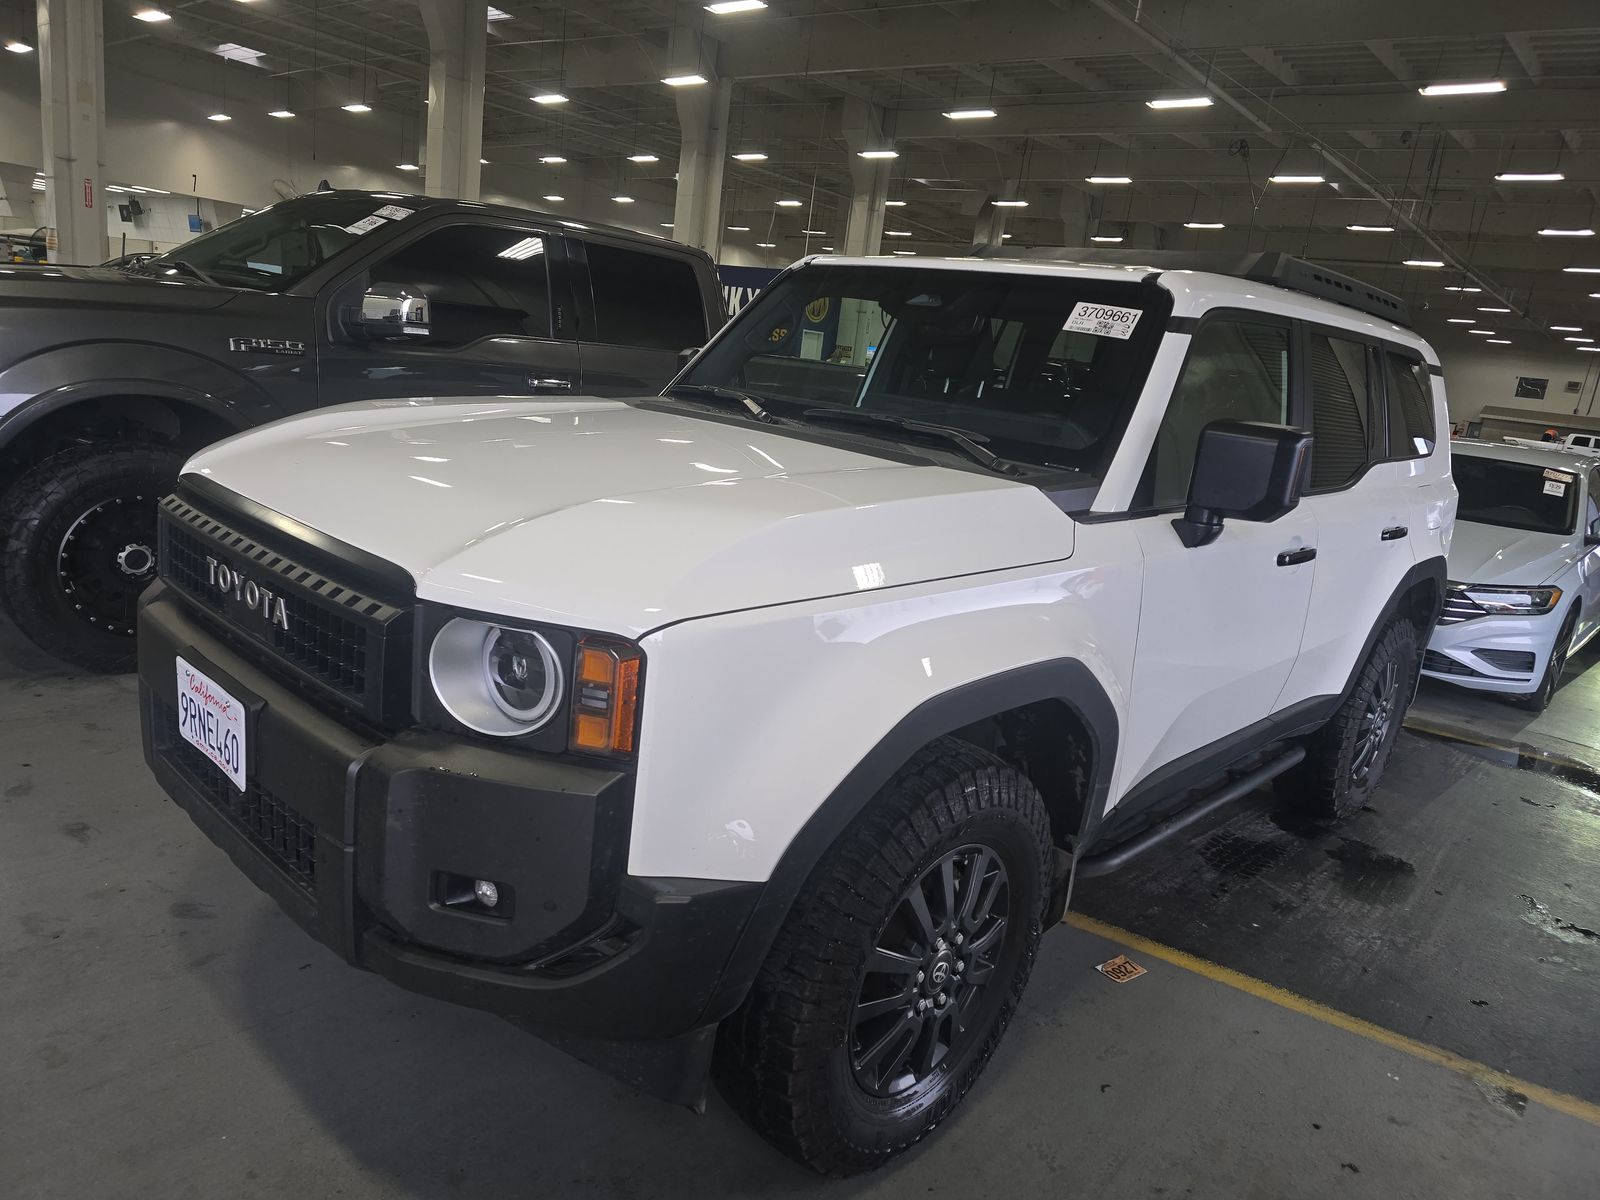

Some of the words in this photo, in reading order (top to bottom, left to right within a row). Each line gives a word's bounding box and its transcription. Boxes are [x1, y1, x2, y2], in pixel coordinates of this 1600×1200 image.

[1078, 305, 1139, 324] 3709661
[206, 555, 289, 630] TOYOTA
[189, 673, 231, 719] California
[181, 692, 239, 774] 9RNE460
[1105, 961, 1138, 979] 0927
